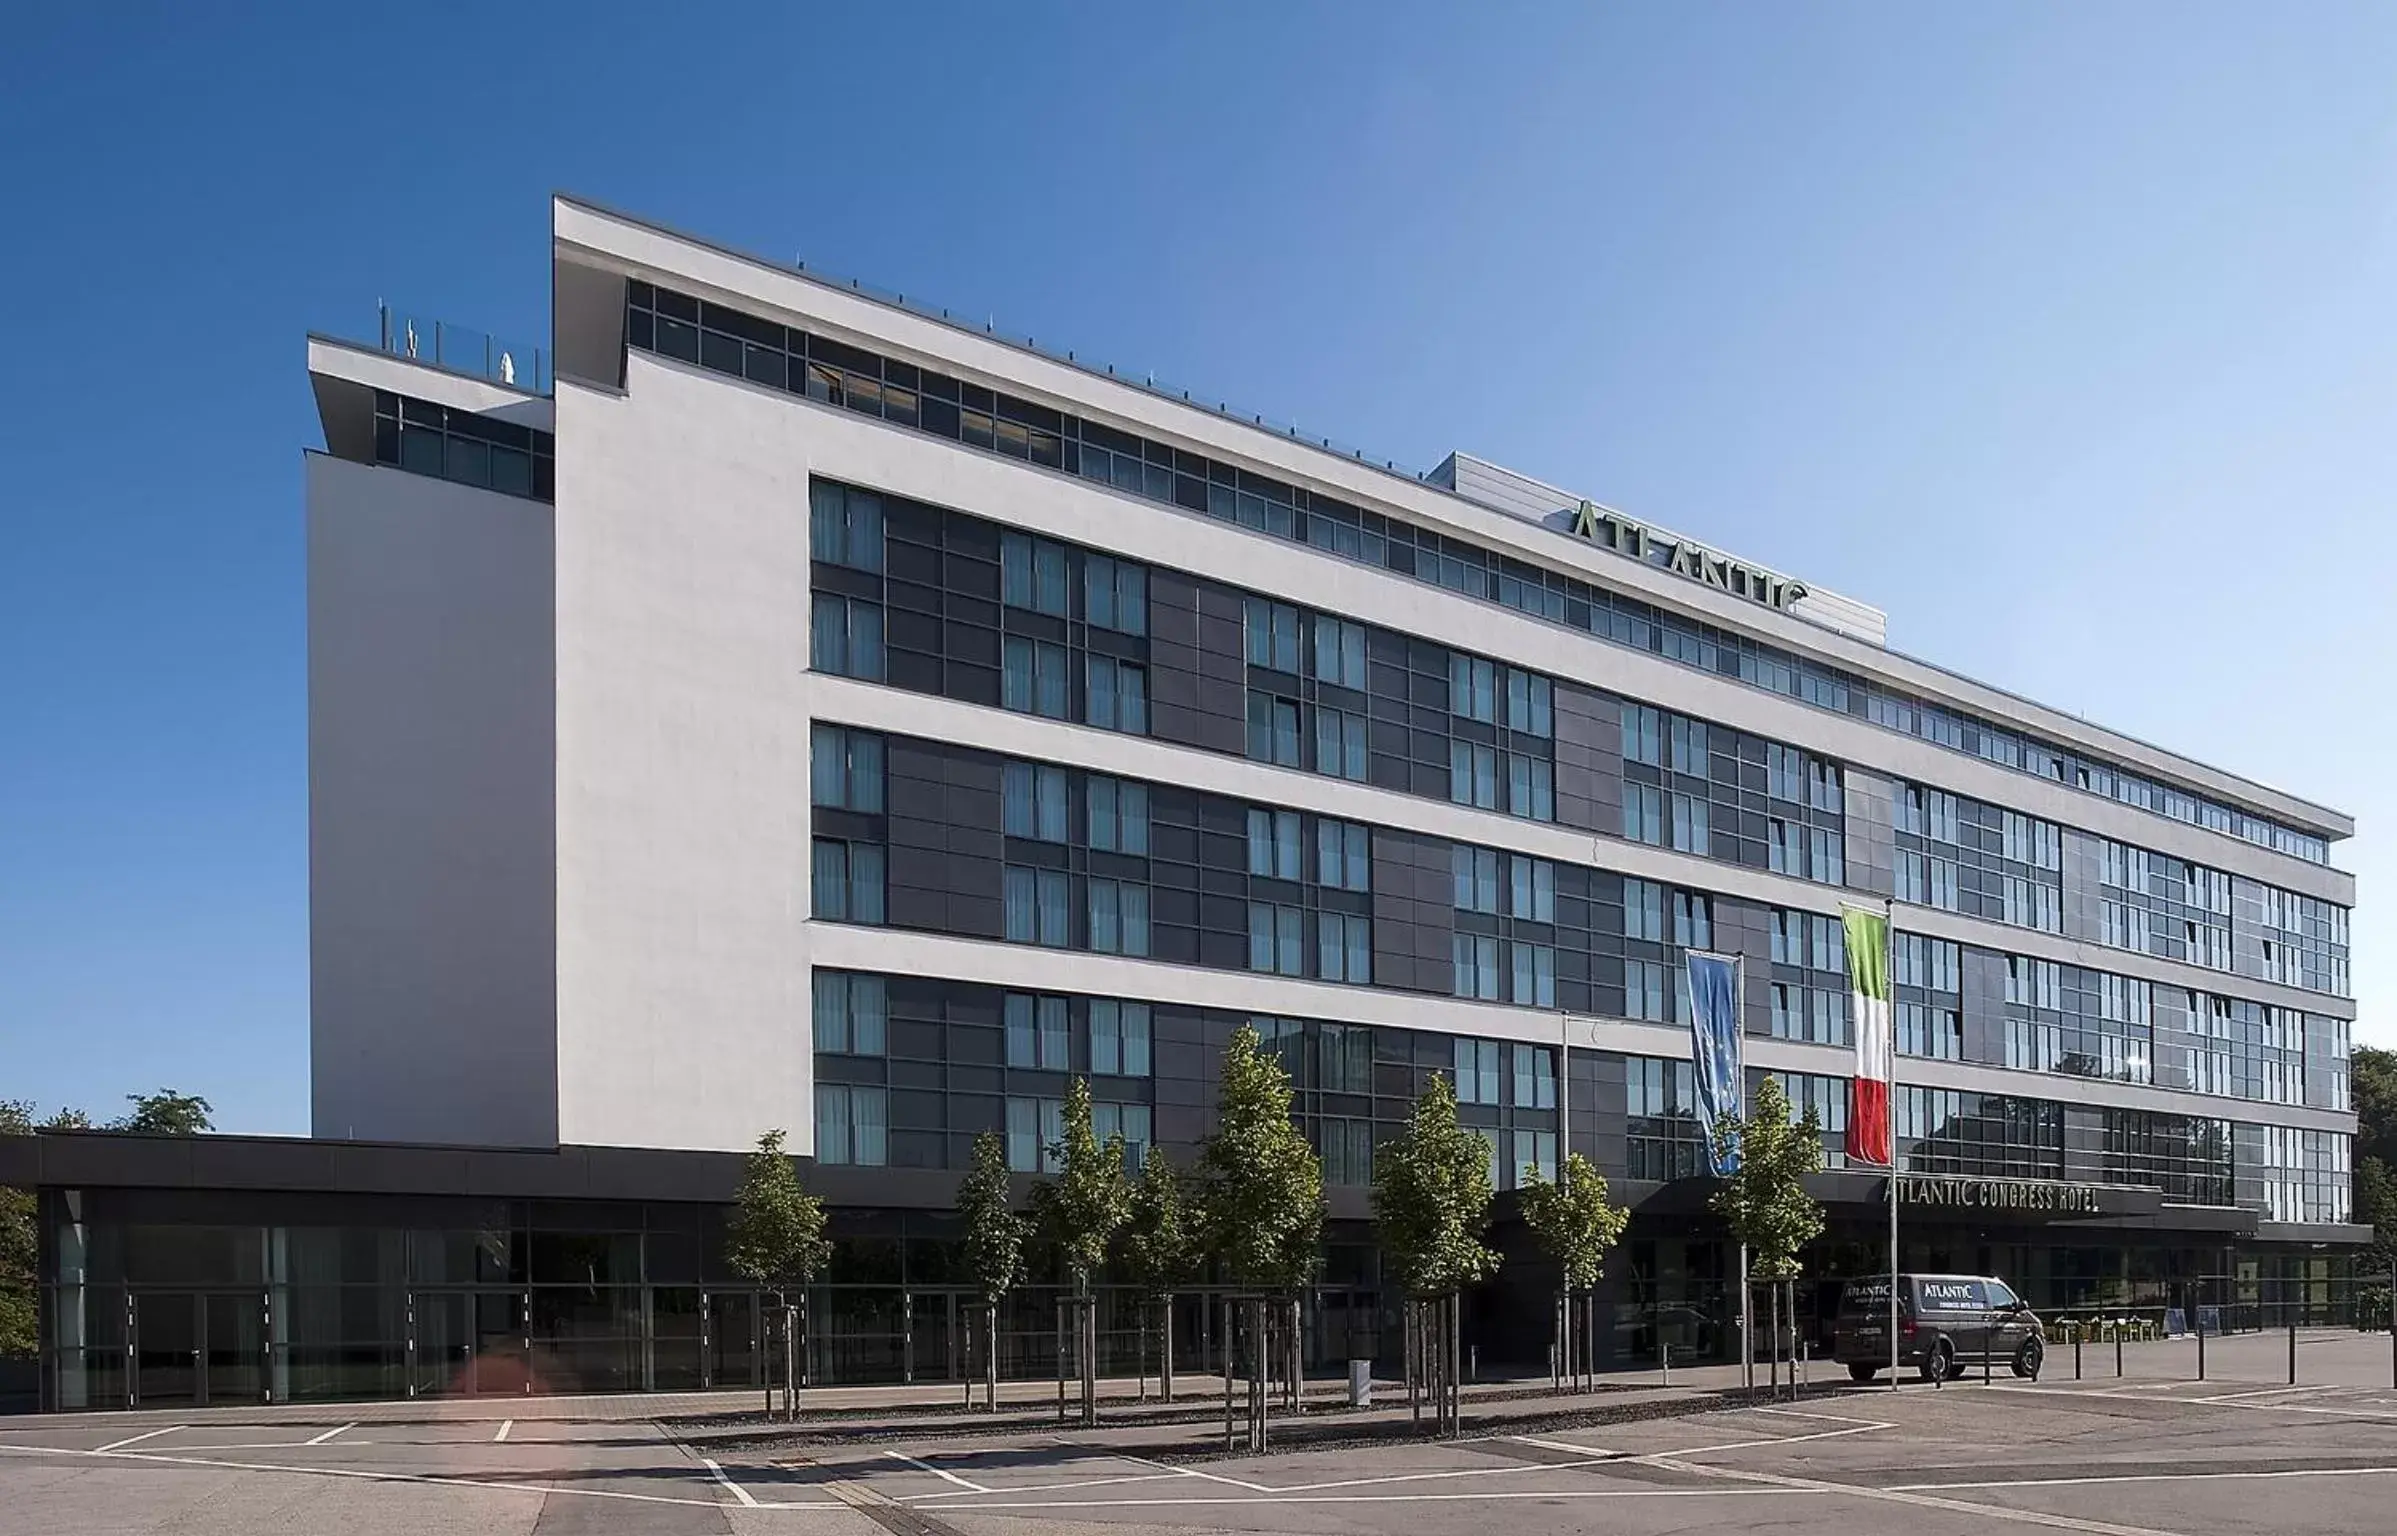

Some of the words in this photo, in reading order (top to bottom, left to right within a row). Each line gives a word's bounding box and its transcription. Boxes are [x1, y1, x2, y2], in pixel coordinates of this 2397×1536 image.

[1574, 499, 1810, 613] ATLANTIC
[1884, 1175, 1975, 1207] ATLANTIC
[1980, 1182, 2053, 1210] CONGRESS
[2058, 1186, 2100, 1213] HOTEL
[1924, 1283, 1974, 1299] ATLANTIC
